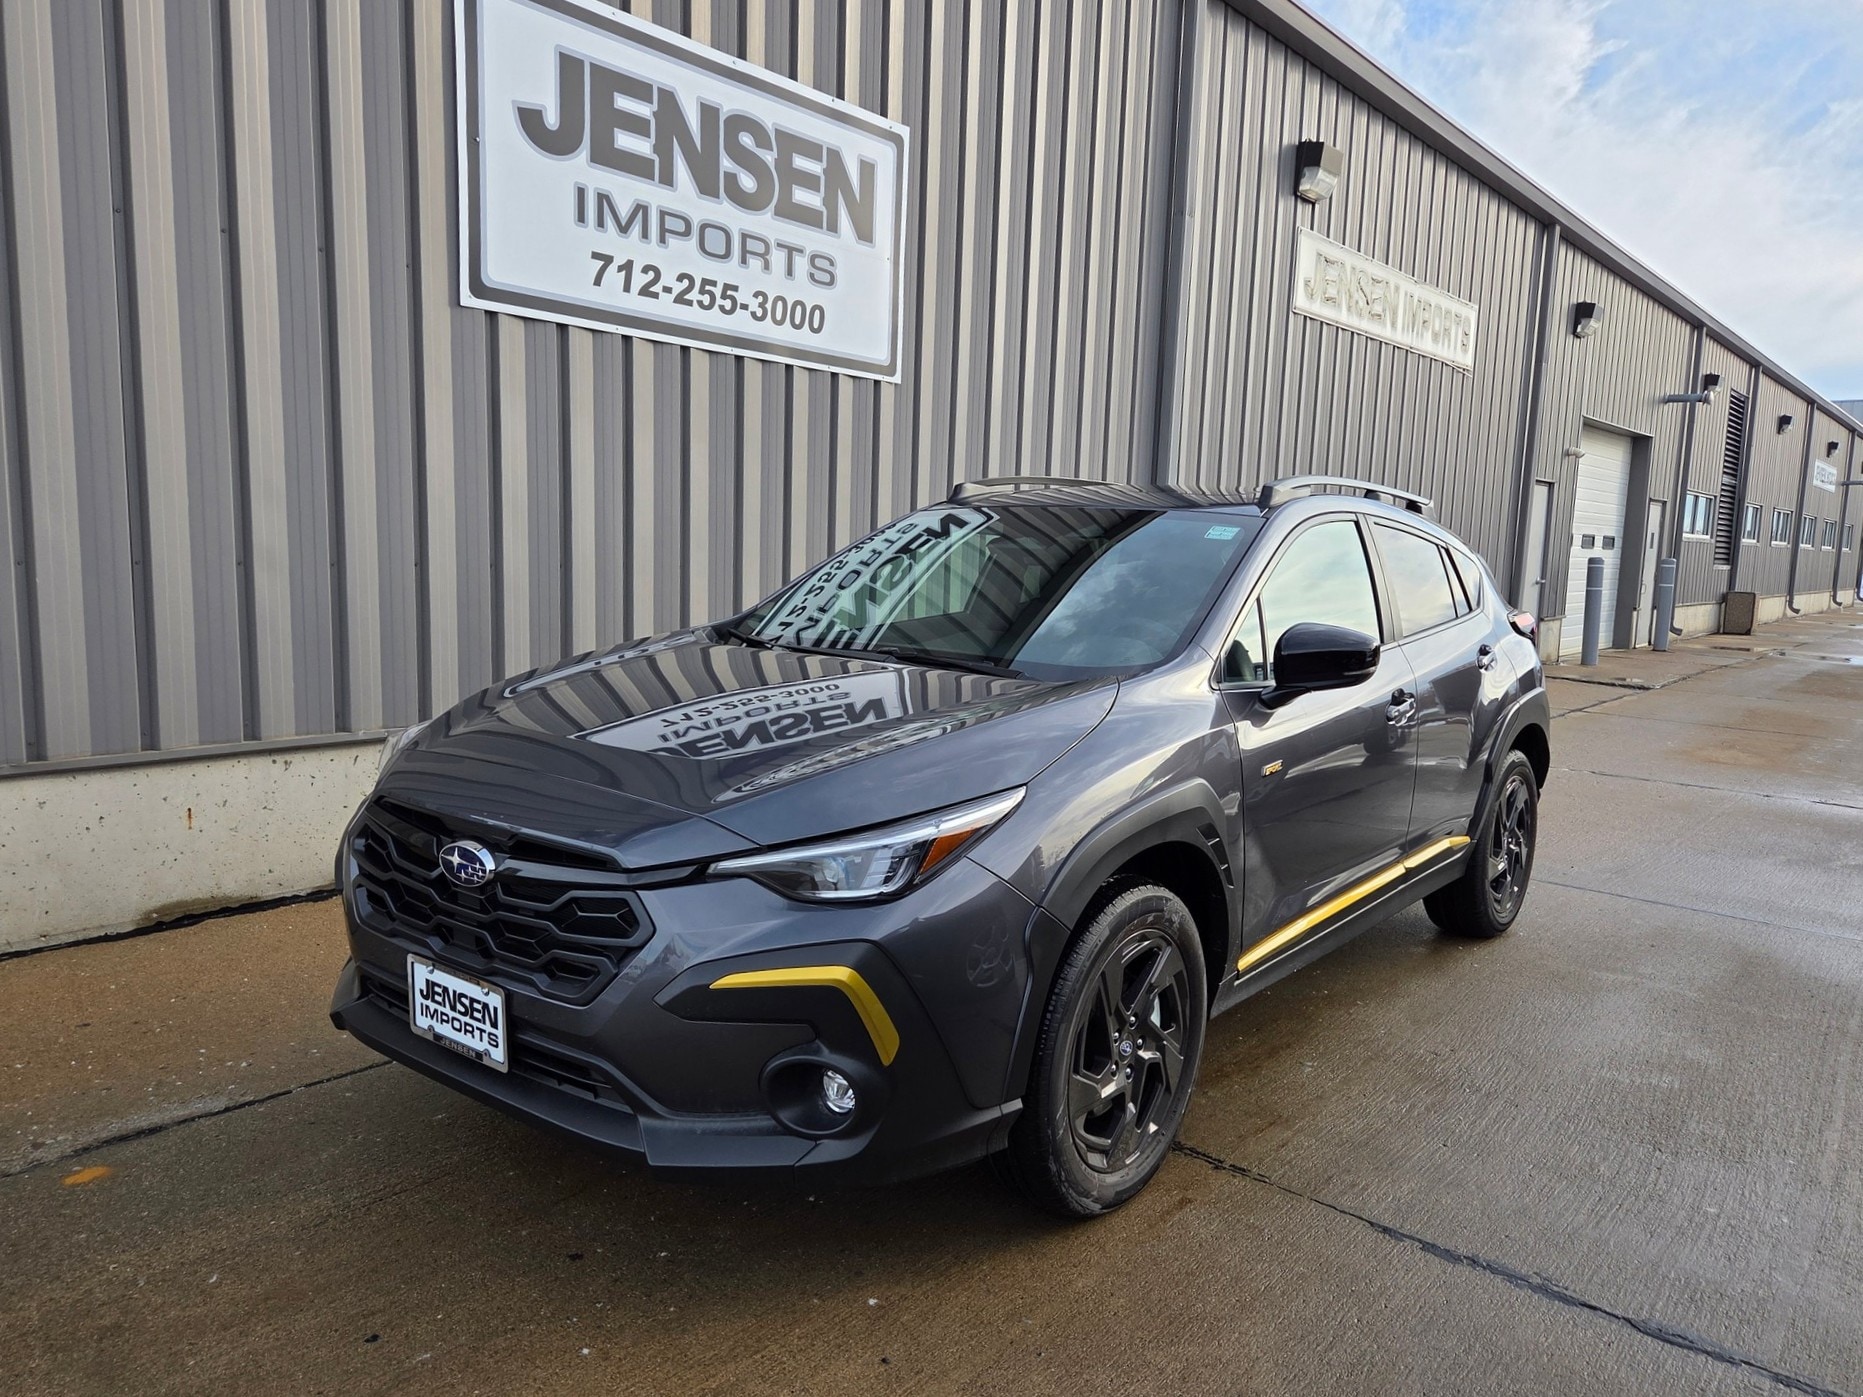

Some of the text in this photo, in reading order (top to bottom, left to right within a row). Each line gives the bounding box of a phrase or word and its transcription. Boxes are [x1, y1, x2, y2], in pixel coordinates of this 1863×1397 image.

[513, 47, 876, 246] JENSEN
[575, 183, 836, 288] IMPORTS
[590, 252, 826, 334] 712-255-3000
[1303, 252, 1472, 353] JENSEN IMPORTS
[419, 978, 499, 1030] JENSEN
[420, 1003, 499, 1049] IMPORTS
[440, 1037, 476, 1058] JENSEN
